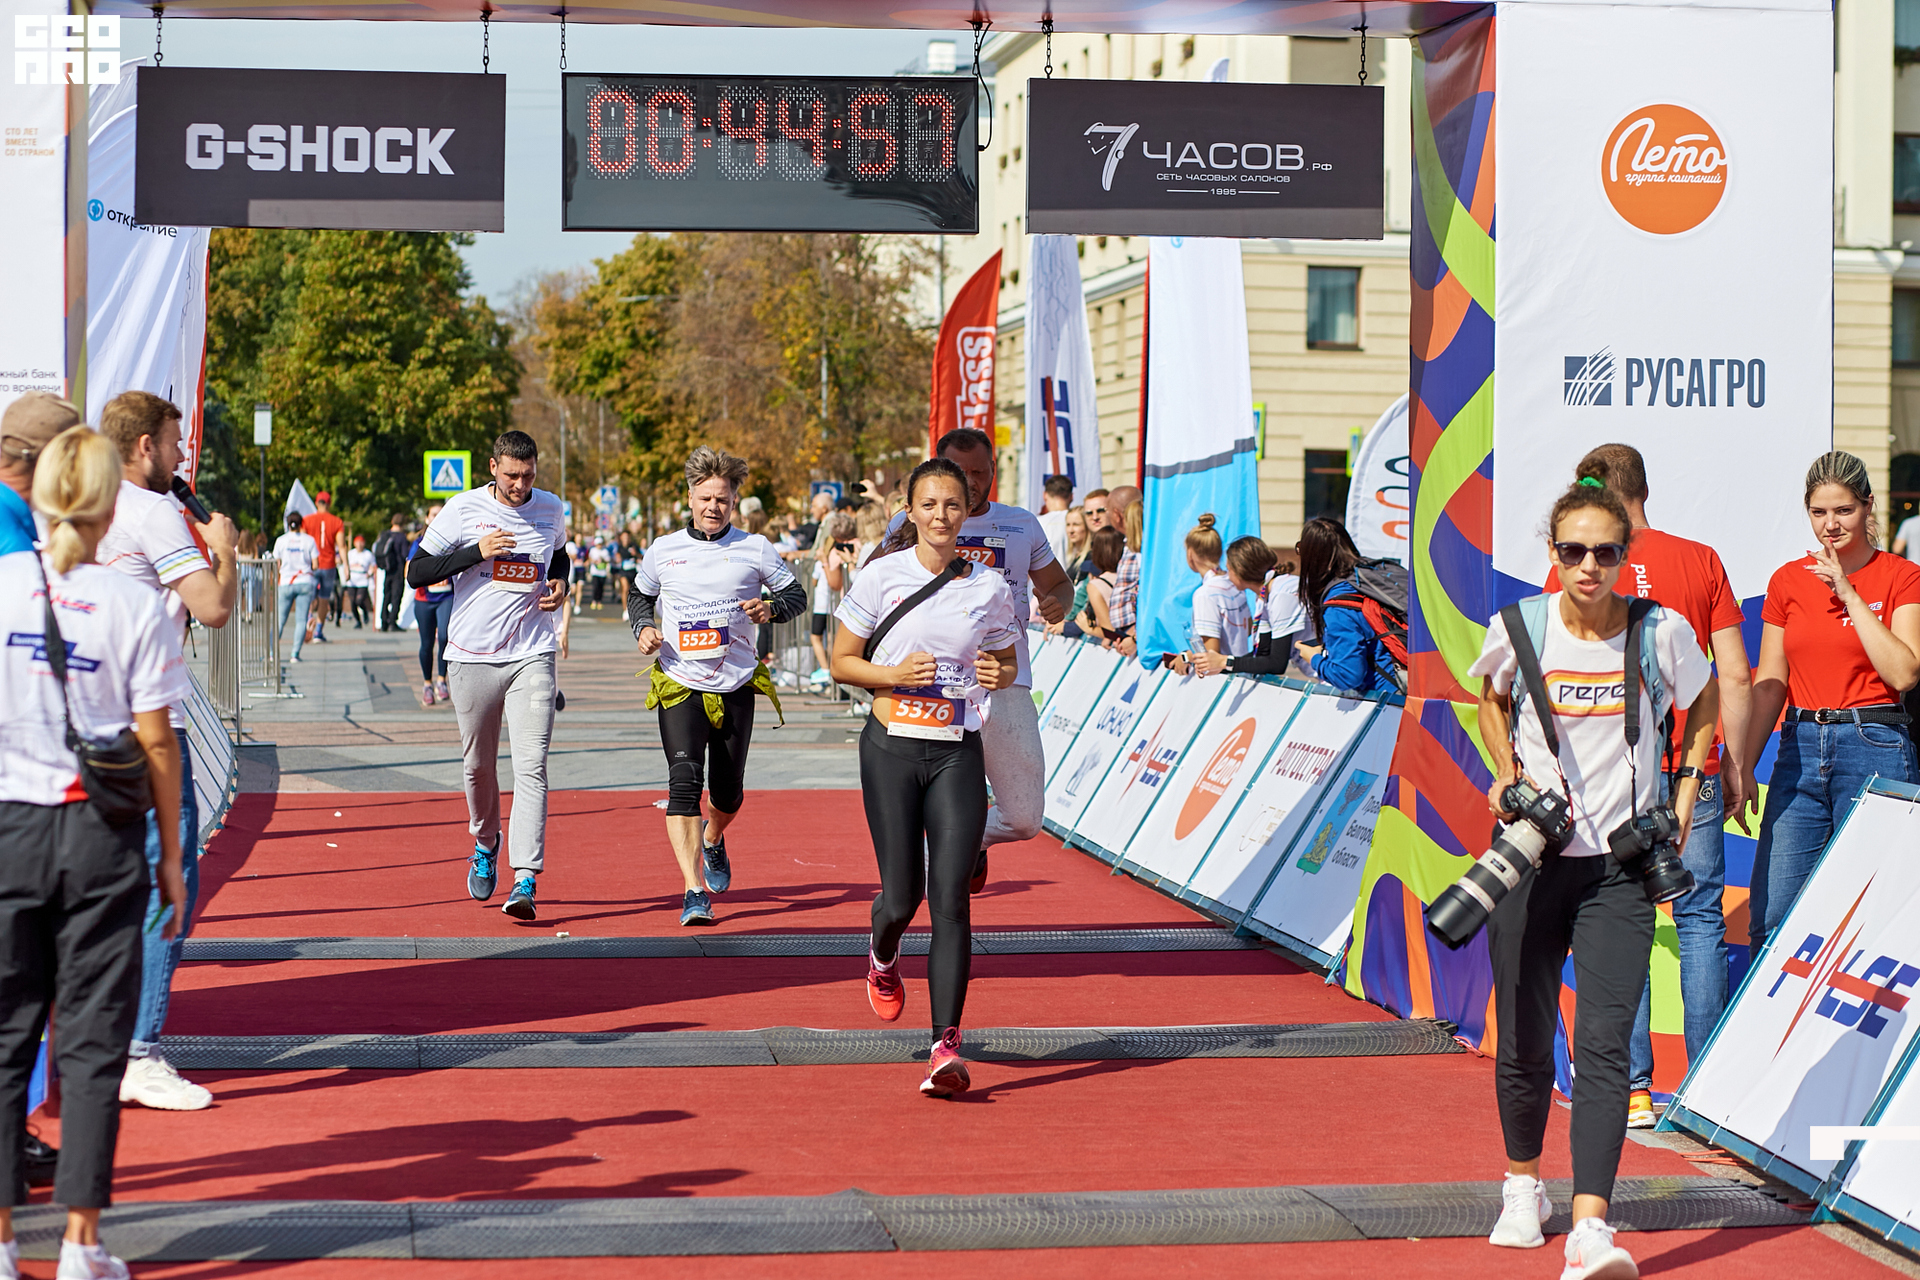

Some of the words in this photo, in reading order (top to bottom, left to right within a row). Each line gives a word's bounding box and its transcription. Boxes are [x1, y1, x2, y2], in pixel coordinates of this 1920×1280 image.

[5, 128, 21, 136] СТО
[23, 128, 38, 136] ЛЕТ
[588, 91, 952, 174] 00:44:57
[5, 138, 37, 146] ВМЕСТЕ
[185, 123, 455, 175] G-SHOCK
[18, 147, 55, 157] СТРАНОЙ
[1610, 117, 1727, 182] Лето
[1156, 172, 1183, 181] СЕТЬ
[1186, 173, 1237, 182] ЧАСОВЫХ
[1240, 174, 1290, 183] САЛОНОВ
[1625, 173, 1666, 187] группа
[1667, 173, 1722, 184] компаний
[1210, 188, 1237, 196] 1995
[31, 368, 57, 379] банк
[13, 384, 61, 394] времени
[1625, 357, 1766, 408] РУСАГРО
[497, 564, 535, 579] 5523
[681, 632, 717, 647] 5522
[895, 699, 950, 721] 5376
